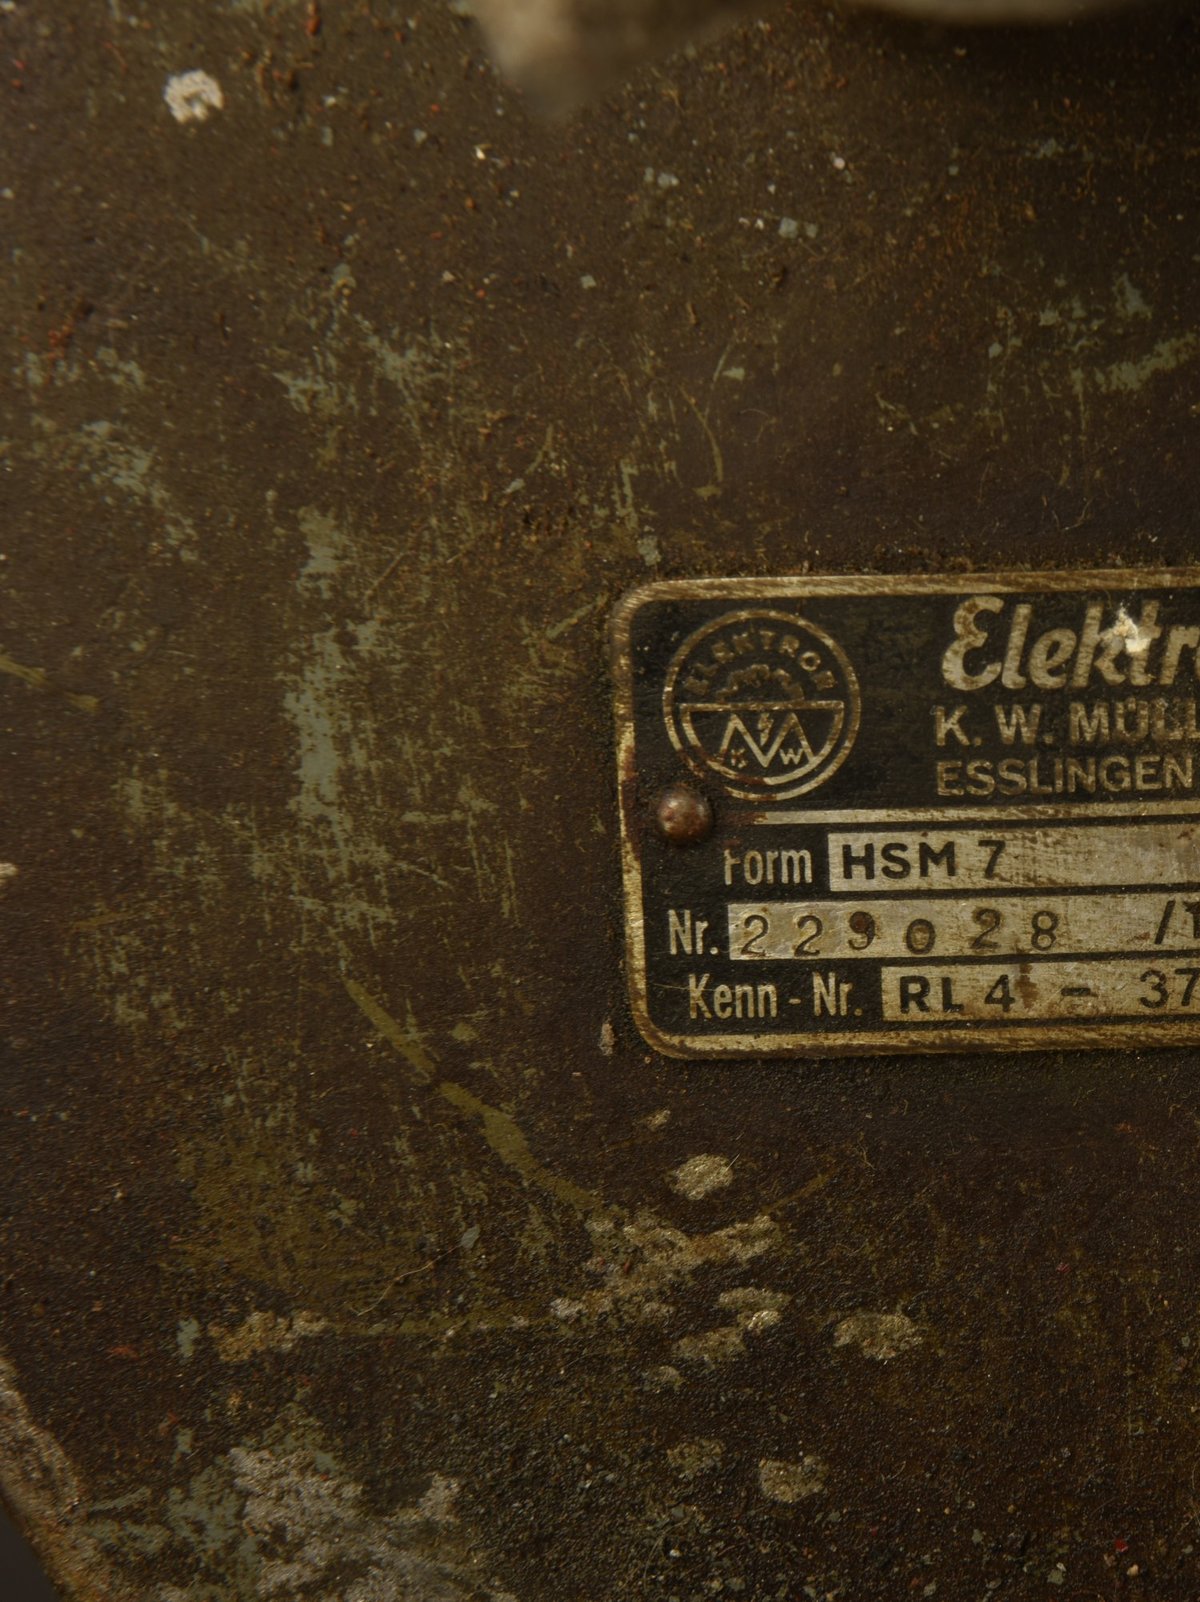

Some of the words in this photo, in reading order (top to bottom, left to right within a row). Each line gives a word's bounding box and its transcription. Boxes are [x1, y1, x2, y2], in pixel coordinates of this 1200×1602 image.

[935, 705, 983, 746] K.
[995, 703, 1054, 745] W.
[936, 755, 1193, 796] ESSLINGEN
[842, 841, 956, 880] HSM
[978, 839, 1006, 879] 7
[667, 909, 720, 956] Nr.
[899, 975, 964, 1014] RL
[984, 974, 1016, 1012] 4
